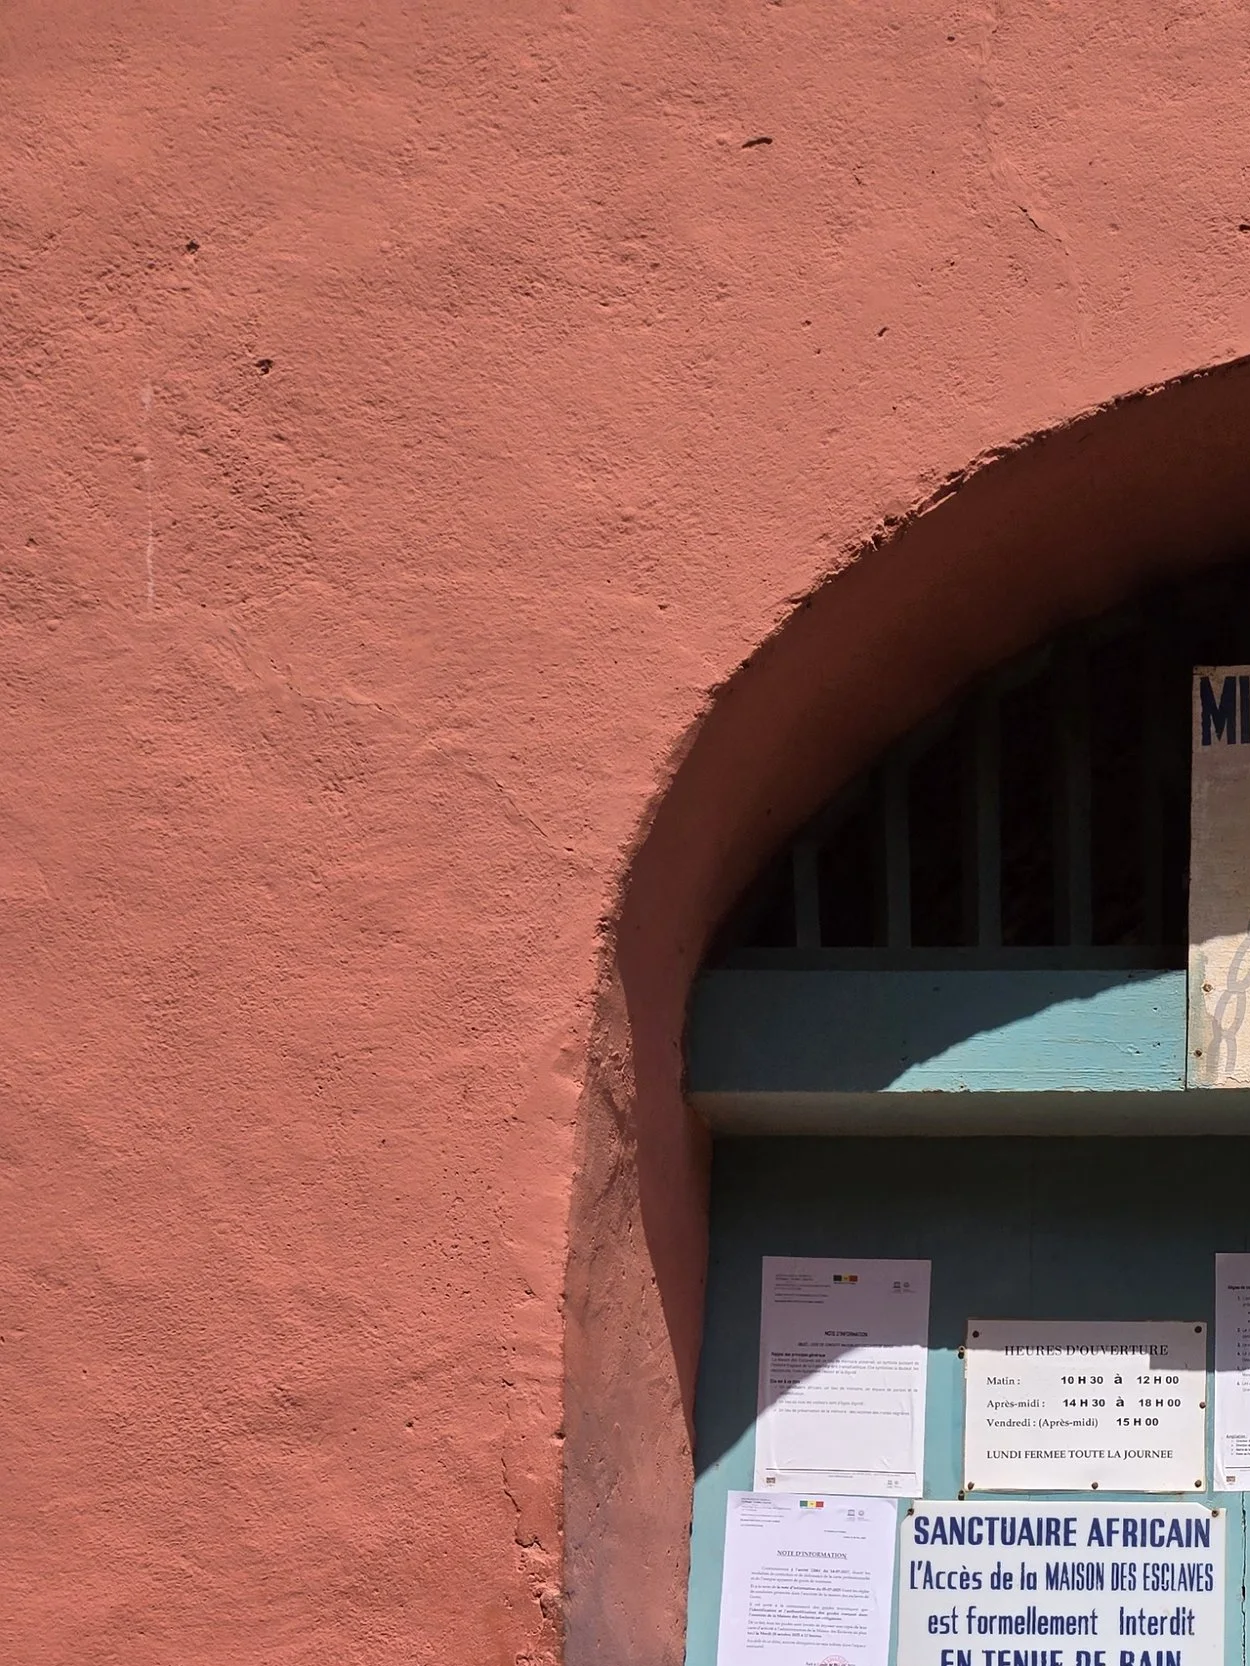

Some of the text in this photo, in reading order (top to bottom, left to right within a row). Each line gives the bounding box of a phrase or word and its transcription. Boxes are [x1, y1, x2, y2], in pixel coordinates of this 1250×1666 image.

[1005, 1344, 1169, 1356] HEURES D'OUVERTURE
[1061, 1376, 1075, 1385] 10
[1090, 1376, 1104, 1385] 30
[1114, 1373, 1123, 1385] à
[1136, 1376, 1150, 1385] 12
[1165, 1376, 1179, 1385] 00
[1063, 1399, 1076, 1407] 14
[1092, 1399, 1105, 1407] 30
[1116, 1396, 1124, 1407] à
[1139, 1399, 1151, 1407] 18
[1167, 1399, 1181, 1407] 00
[1038, 1418, 1098, 1430] (Après-midi)
[1116, 1418, 1130, 1426] 15
[1145, 1418, 1159, 1426] 00
[986, 1450, 1173, 1460] LUNDI FERMEE TOUTE LA JOURNEE
[914, 1516, 1211, 1548] SANCTUAIRE AFRICAIN
[990, 1561, 1013, 1590] de
[1020, 1561, 1037, 1591] la
[1046, 1562, 1104, 1592] MAISON
[1111, 1562, 1136, 1592] DES
[1143, 1562, 1214, 1592] ESCLAVES
[928, 1606, 1195, 1636] est formellement Interdit
